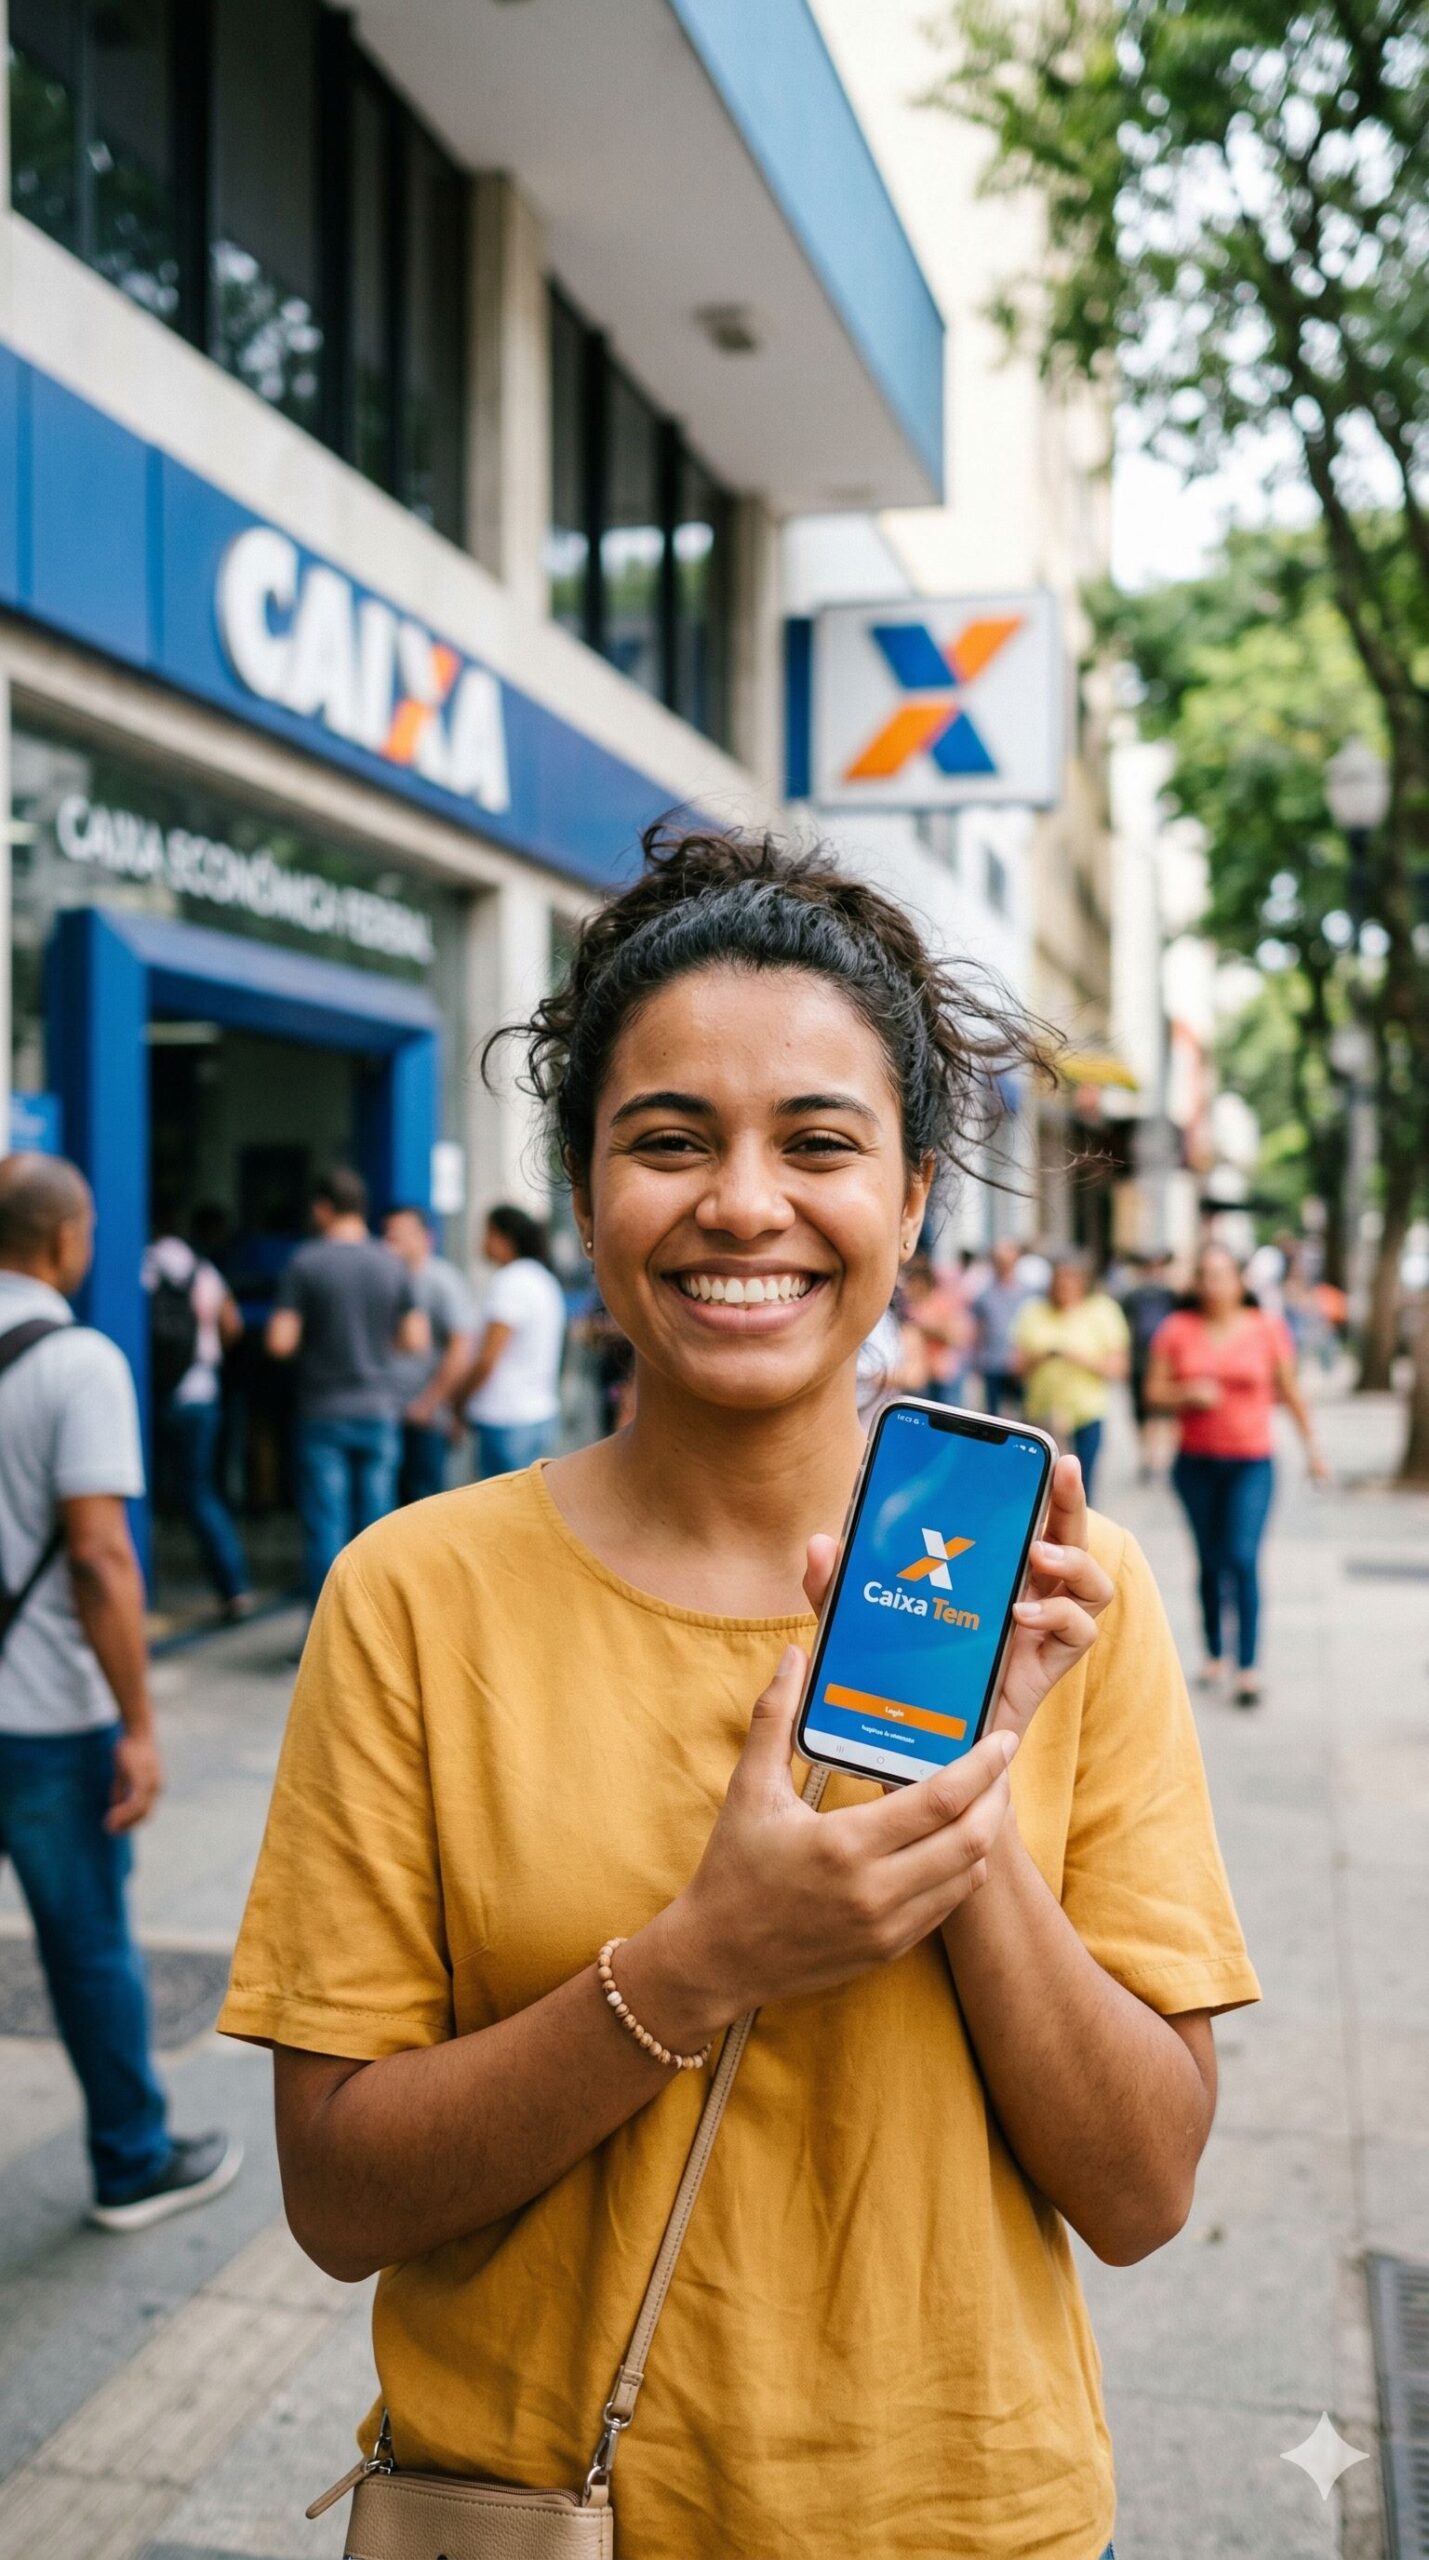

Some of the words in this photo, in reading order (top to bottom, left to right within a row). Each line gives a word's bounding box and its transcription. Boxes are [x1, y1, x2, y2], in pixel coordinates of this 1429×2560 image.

[218, 526, 511, 815] CAIXA
[863, 1581, 928, 1617] Caixa
[932, 1597, 980, 1631] Tem
